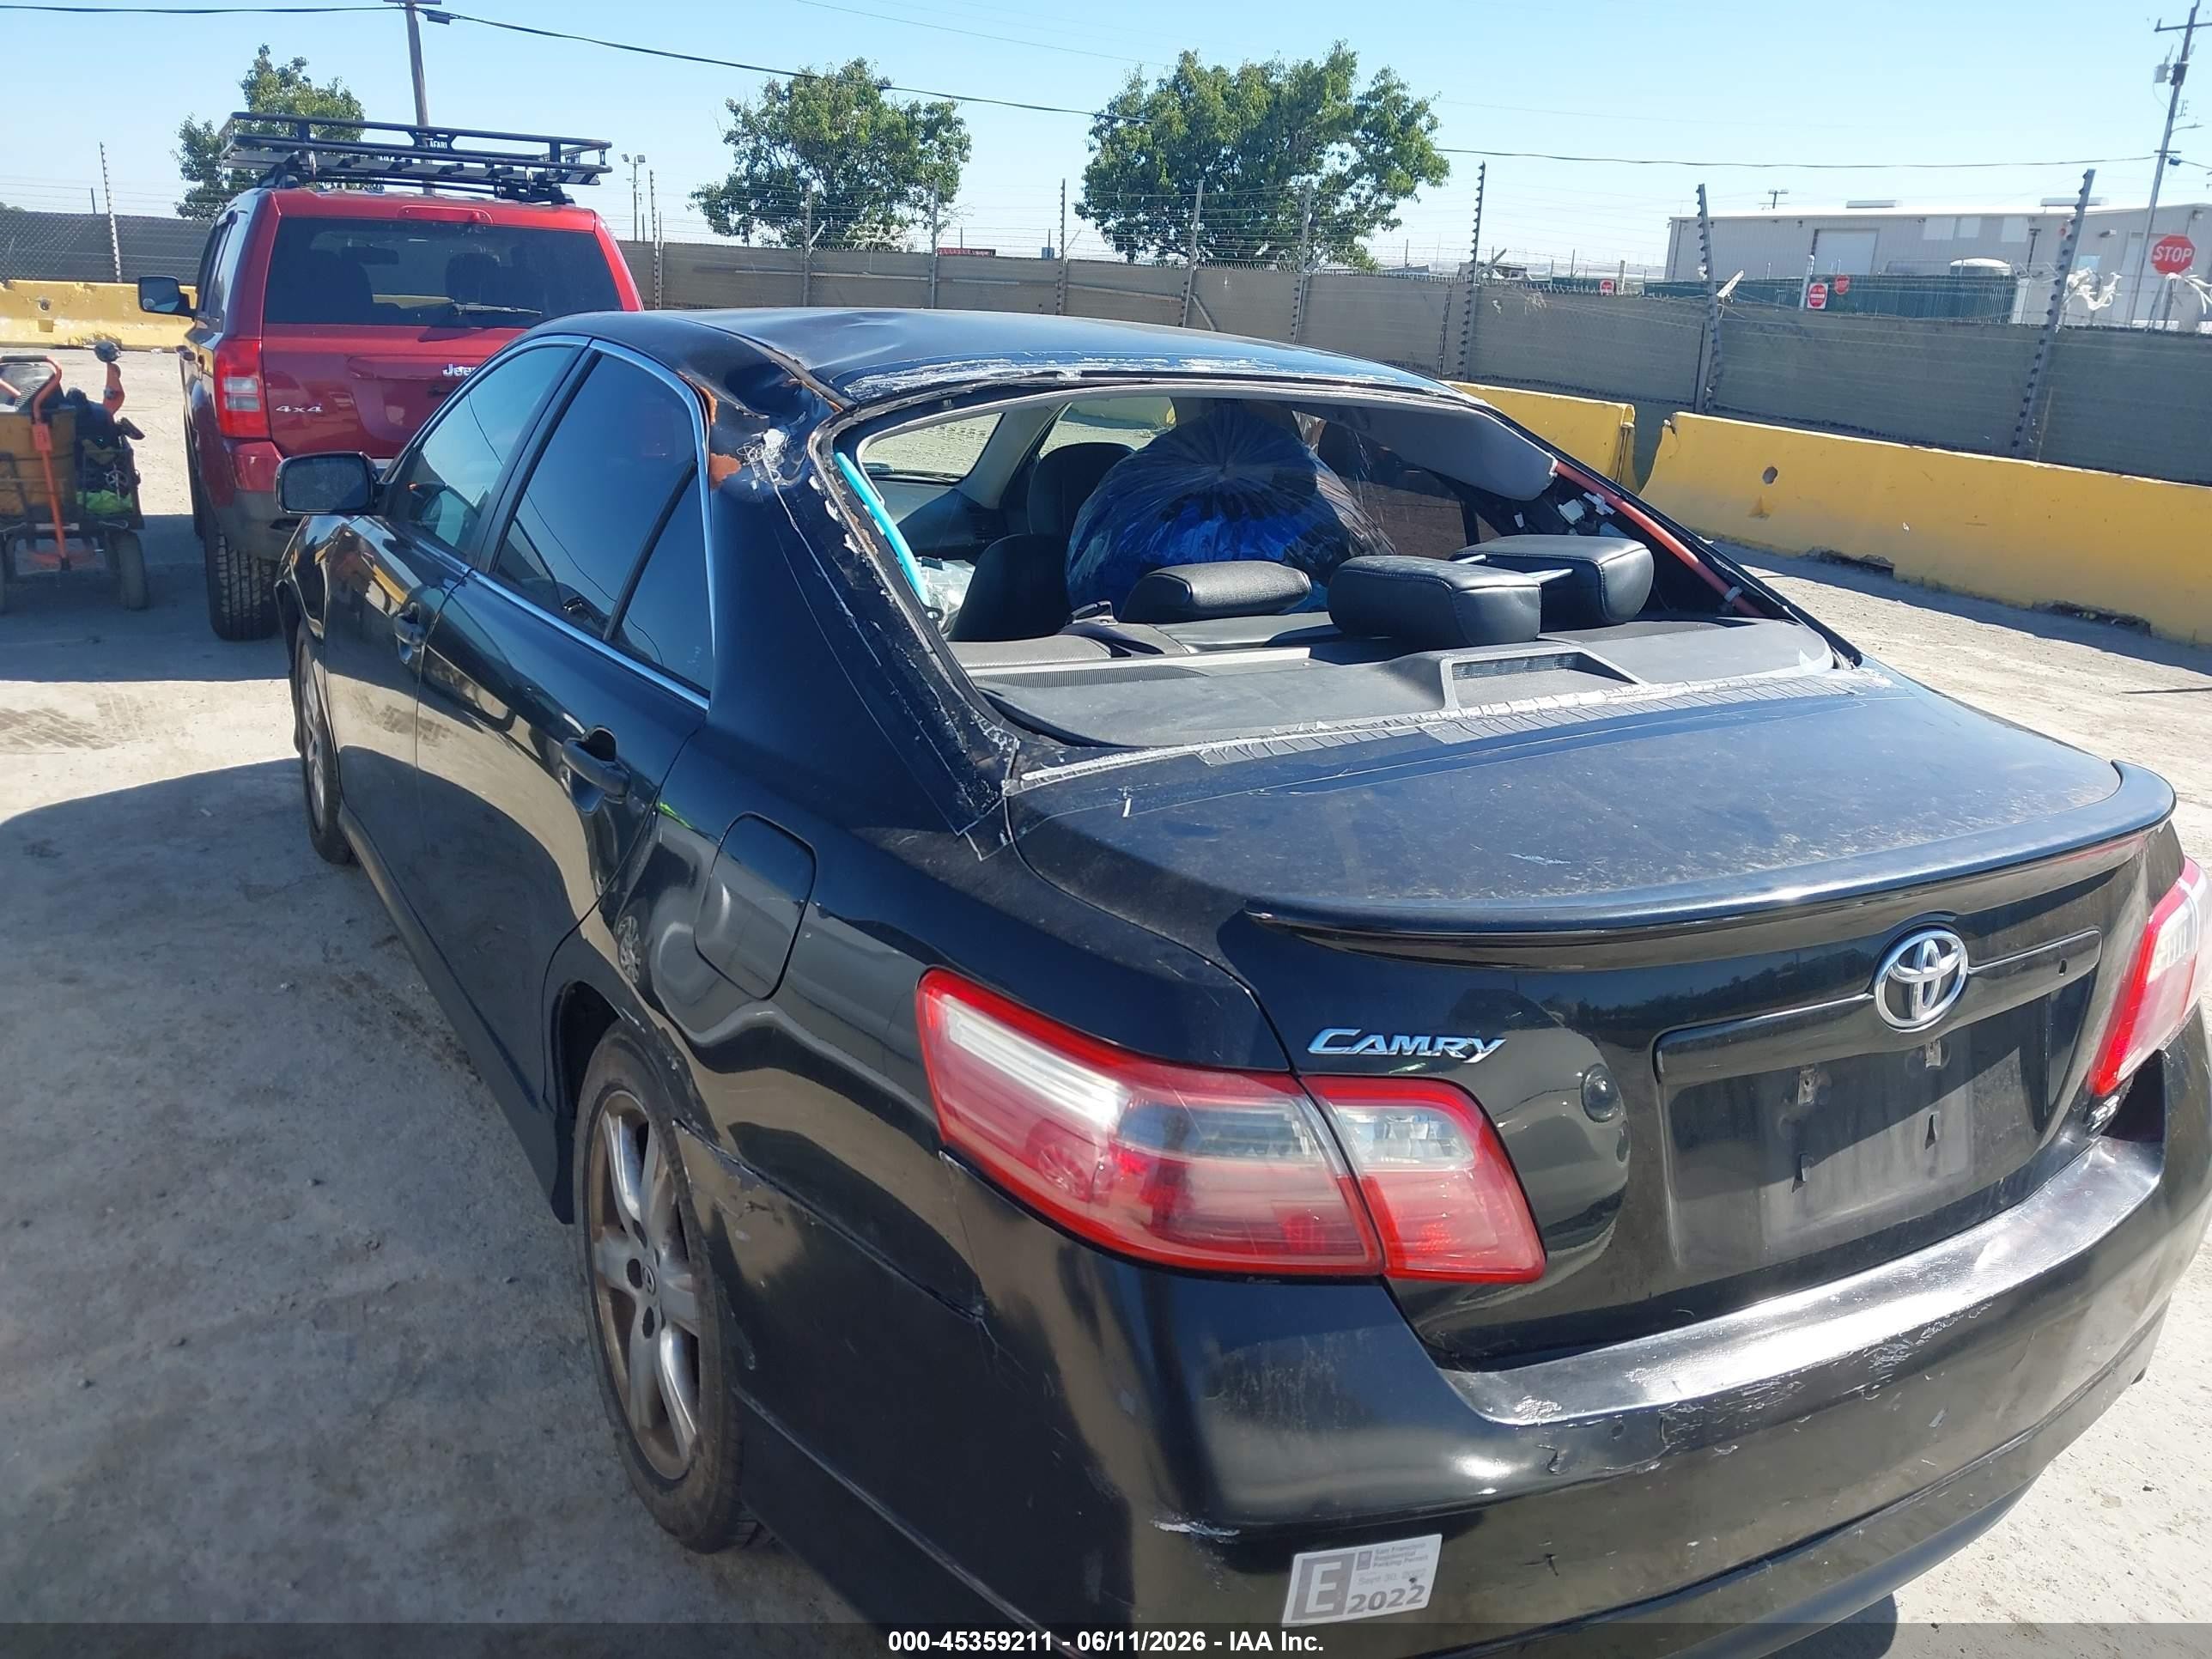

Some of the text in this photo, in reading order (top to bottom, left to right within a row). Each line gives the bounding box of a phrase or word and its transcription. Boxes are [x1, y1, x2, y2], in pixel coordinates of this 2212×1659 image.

[2153, 246, 2192, 263] STOP
[442, 363, 477, 377] Jee
[1308, 1028, 1506, 1064] CAMRY
[1305, 1561, 1341, 1613] E
[1347, 1584, 1426, 1614] 2022
